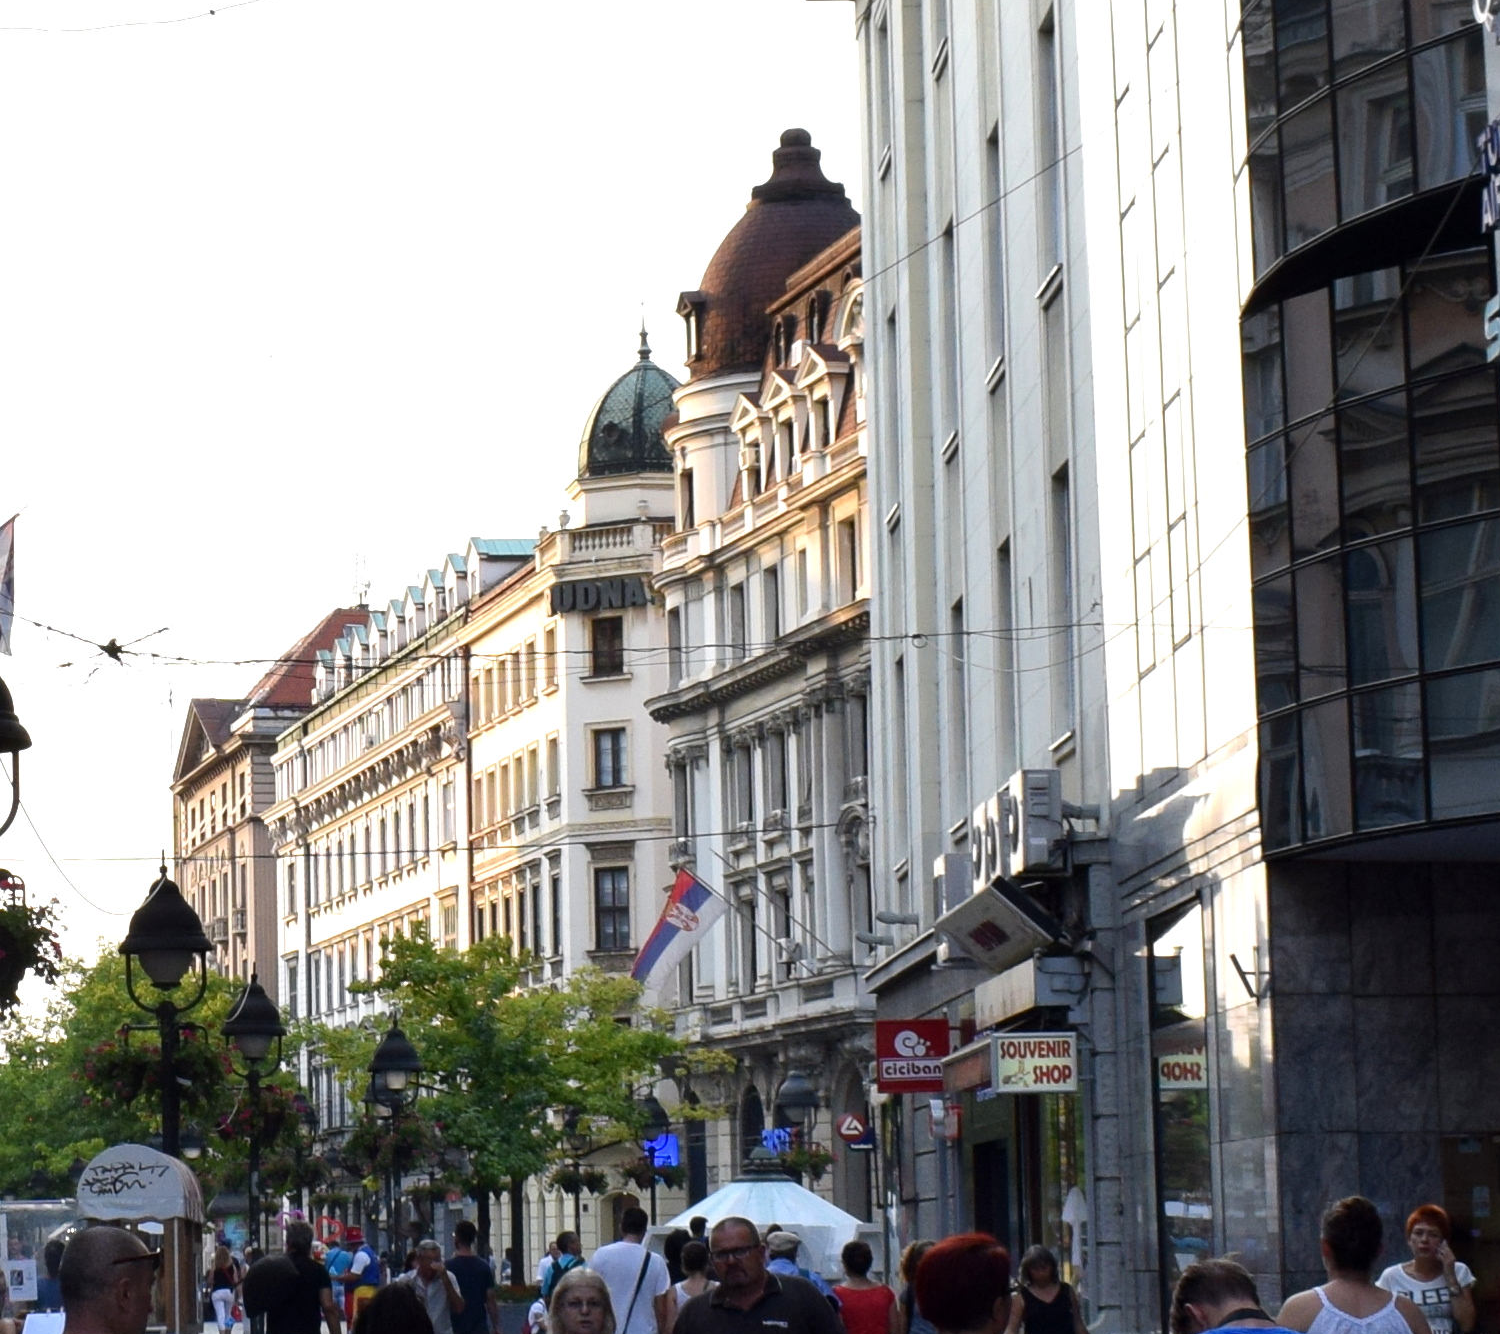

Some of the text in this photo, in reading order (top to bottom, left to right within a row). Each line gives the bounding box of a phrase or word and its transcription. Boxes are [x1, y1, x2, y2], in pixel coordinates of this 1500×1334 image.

[1000, 1040, 1072, 1060] SOUVENIR
[884, 1059, 943, 1078] ciciban
[1031, 1064, 1072, 1085] SHOP
